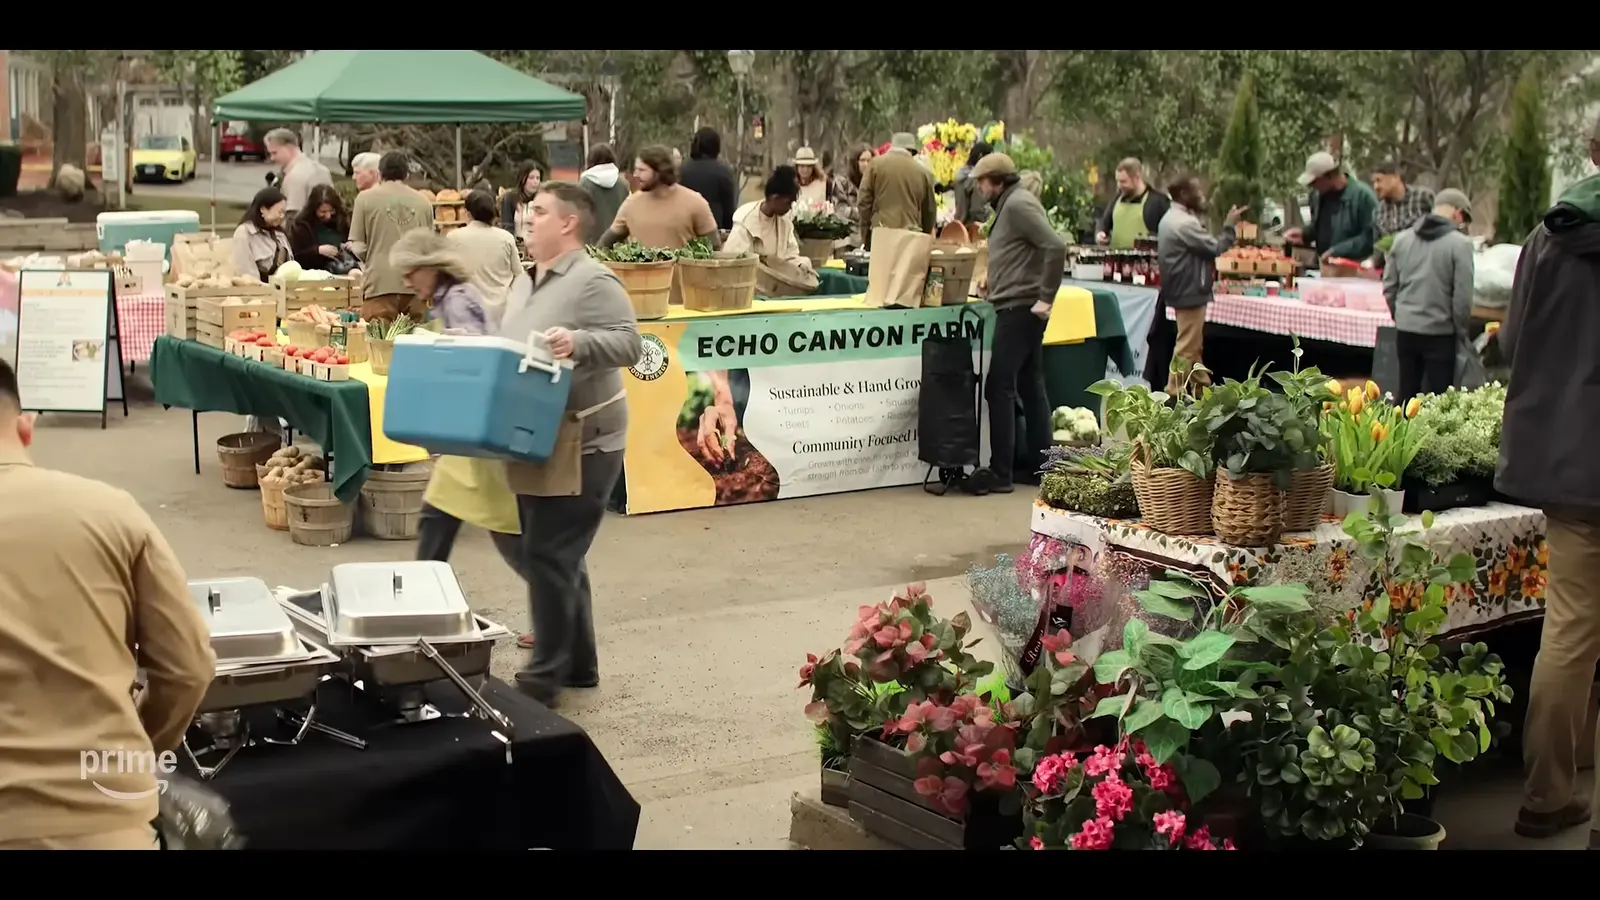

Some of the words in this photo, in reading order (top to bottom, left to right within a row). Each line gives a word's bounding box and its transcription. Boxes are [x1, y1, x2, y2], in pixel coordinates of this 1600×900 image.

[697, 334, 778, 358] ECHO
[788, 325, 904, 353] CANYON
[769, 383, 840, 400] Sustainable
[843, 382, 855, 395] &
[858, 378, 892, 393] Hand
[783, 406, 815, 416] Turnips
[834, 402, 864, 412] Onions
[785, 420, 810, 430] Beets
[836, 415, 874, 426] Potatoes
[792, 437, 865, 455] Community
[867, 429, 911, 448] Focused
[808, 460, 834, 470] Grown
[835, 456, 853, 466] with
[807, 469, 836, 481] straight
[839, 468, 858, 477] from
